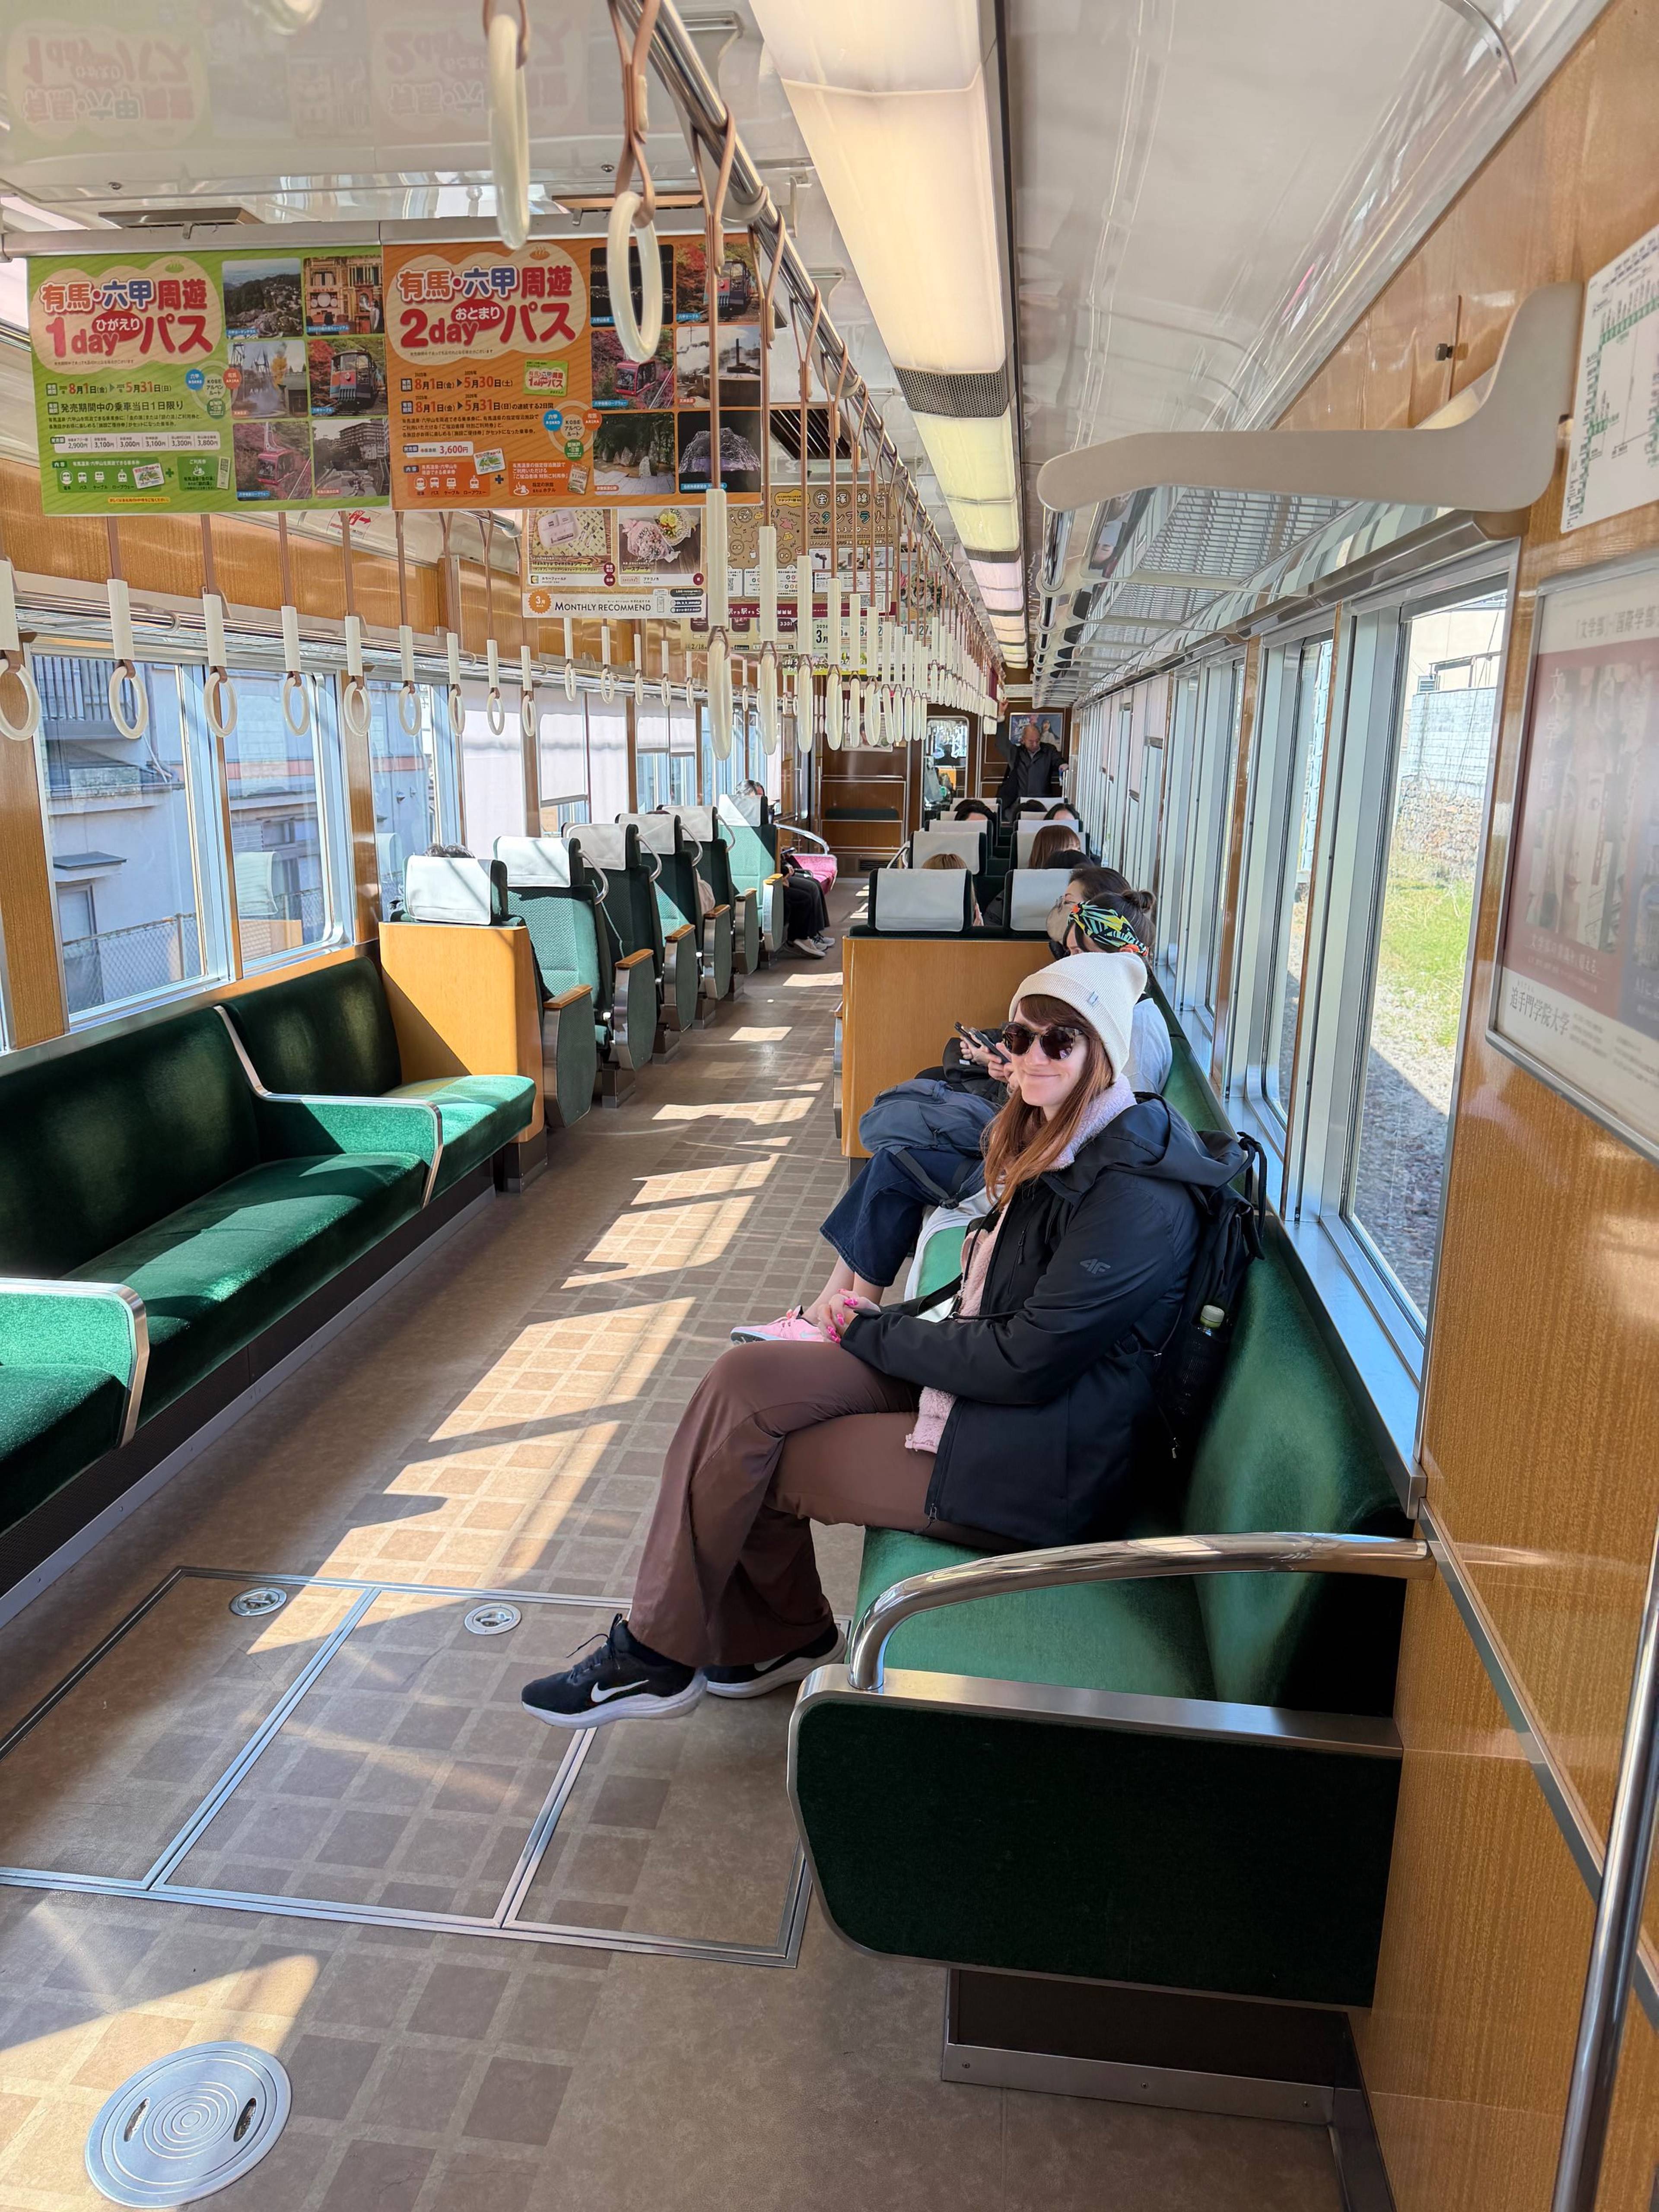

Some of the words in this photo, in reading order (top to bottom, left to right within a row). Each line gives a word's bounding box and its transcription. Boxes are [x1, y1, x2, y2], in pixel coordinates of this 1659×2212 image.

[41, 278, 207, 314] 有馬・六甲周遊
[397, 266, 572, 303] 有馬・六甲周遊
[46, 317, 119, 358] 1day
[95, 318, 140, 331] ひがえり
[139, 314, 213, 353] パス
[400, 308, 478, 347] 2day
[455, 307, 500, 321] おとまり
[500, 302, 575, 343] パス
[439, 445, 468, 454] 3,600円
